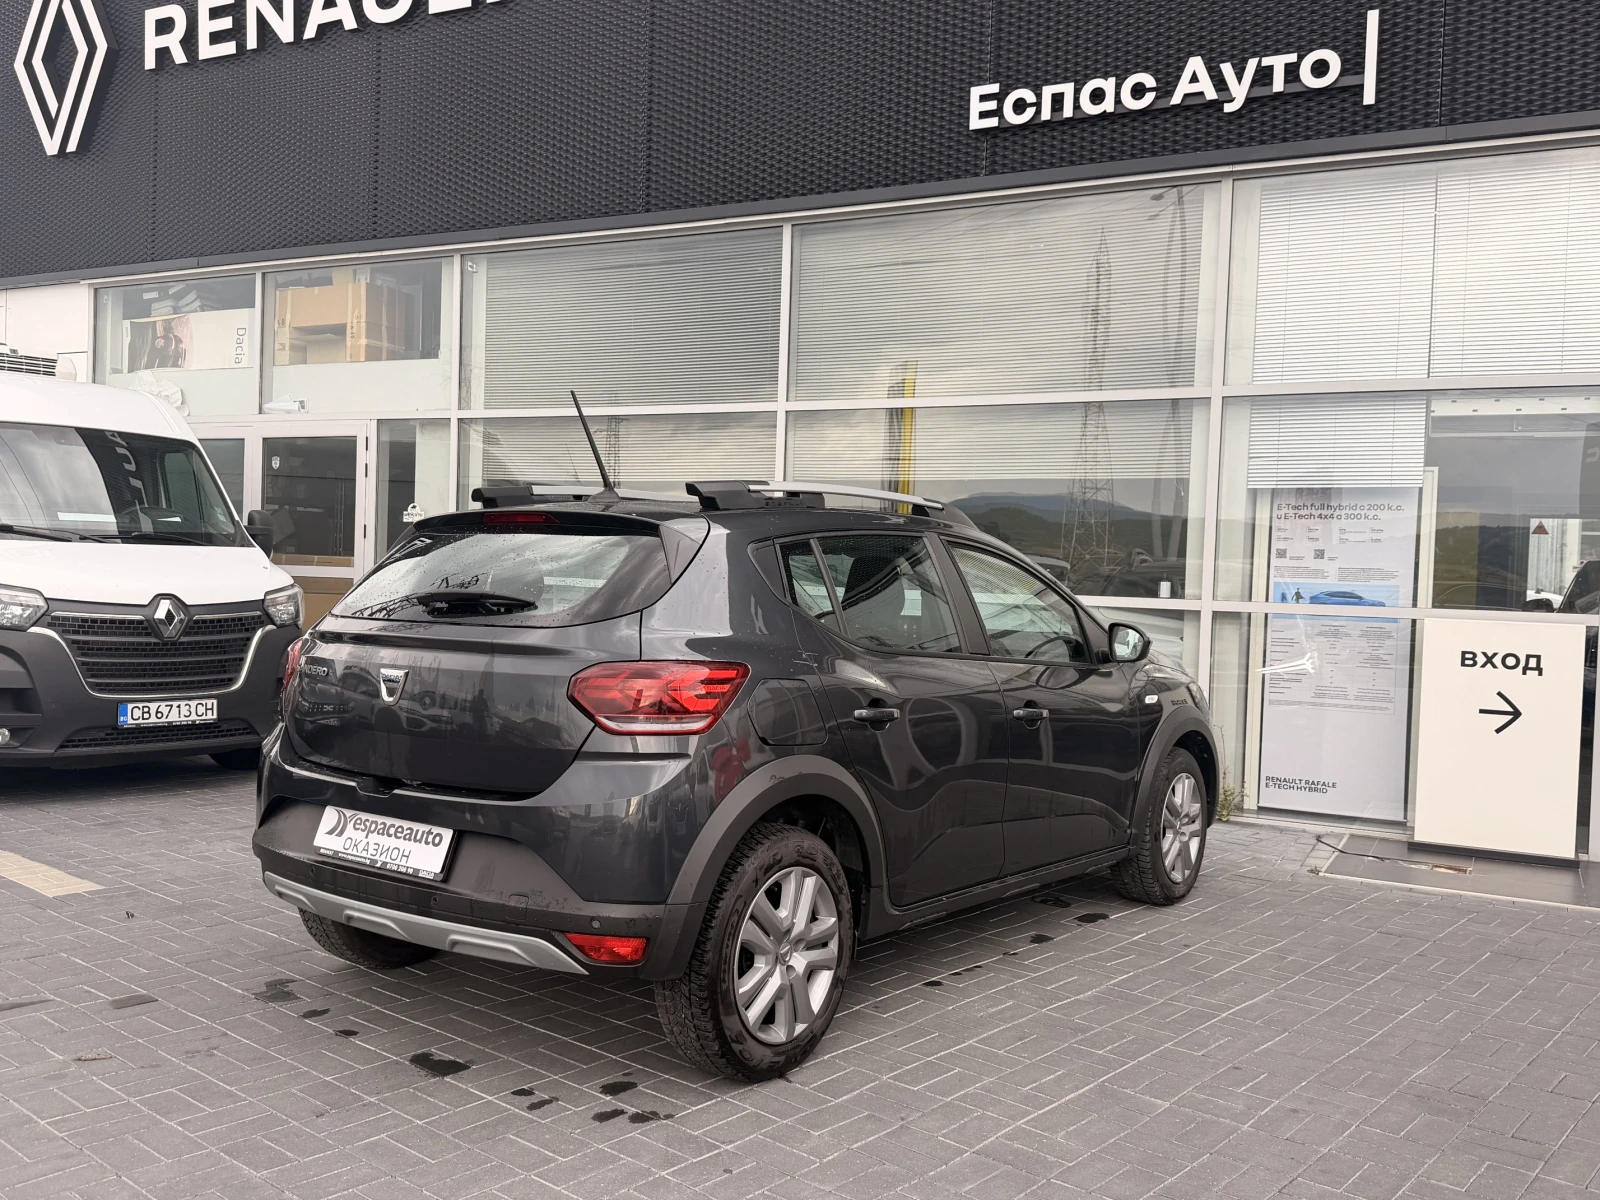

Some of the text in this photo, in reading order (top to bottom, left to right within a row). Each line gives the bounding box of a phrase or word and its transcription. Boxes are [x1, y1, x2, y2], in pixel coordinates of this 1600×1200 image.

[144, 0, 510, 71] RENA
[969, 48, 1342, 131] Еспас Ауто
[234, 327, 247, 365] Dacia
[1277, 503, 1309, 511] E-Tech
[1310, 503, 1325, 511] full
[1326, 502, 1358, 513] hybrid
[1366, 503, 1386, 511] 200
[1284, 512, 1316, 520] E-Tech
[1317, 512, 1335, 520] 4x4
[1343, 512, 1363, 520] 300
[130, 701, 215, 721] CB 6713 CH
[1265, 775, 1338, 789] RENAULT RAFALE
[1265, 782, 1328, 794] E-TECH HYBRID
[352, 816, 443, 848] espaceauto
[342, 837, 412, 864] ОКАЗИОН
